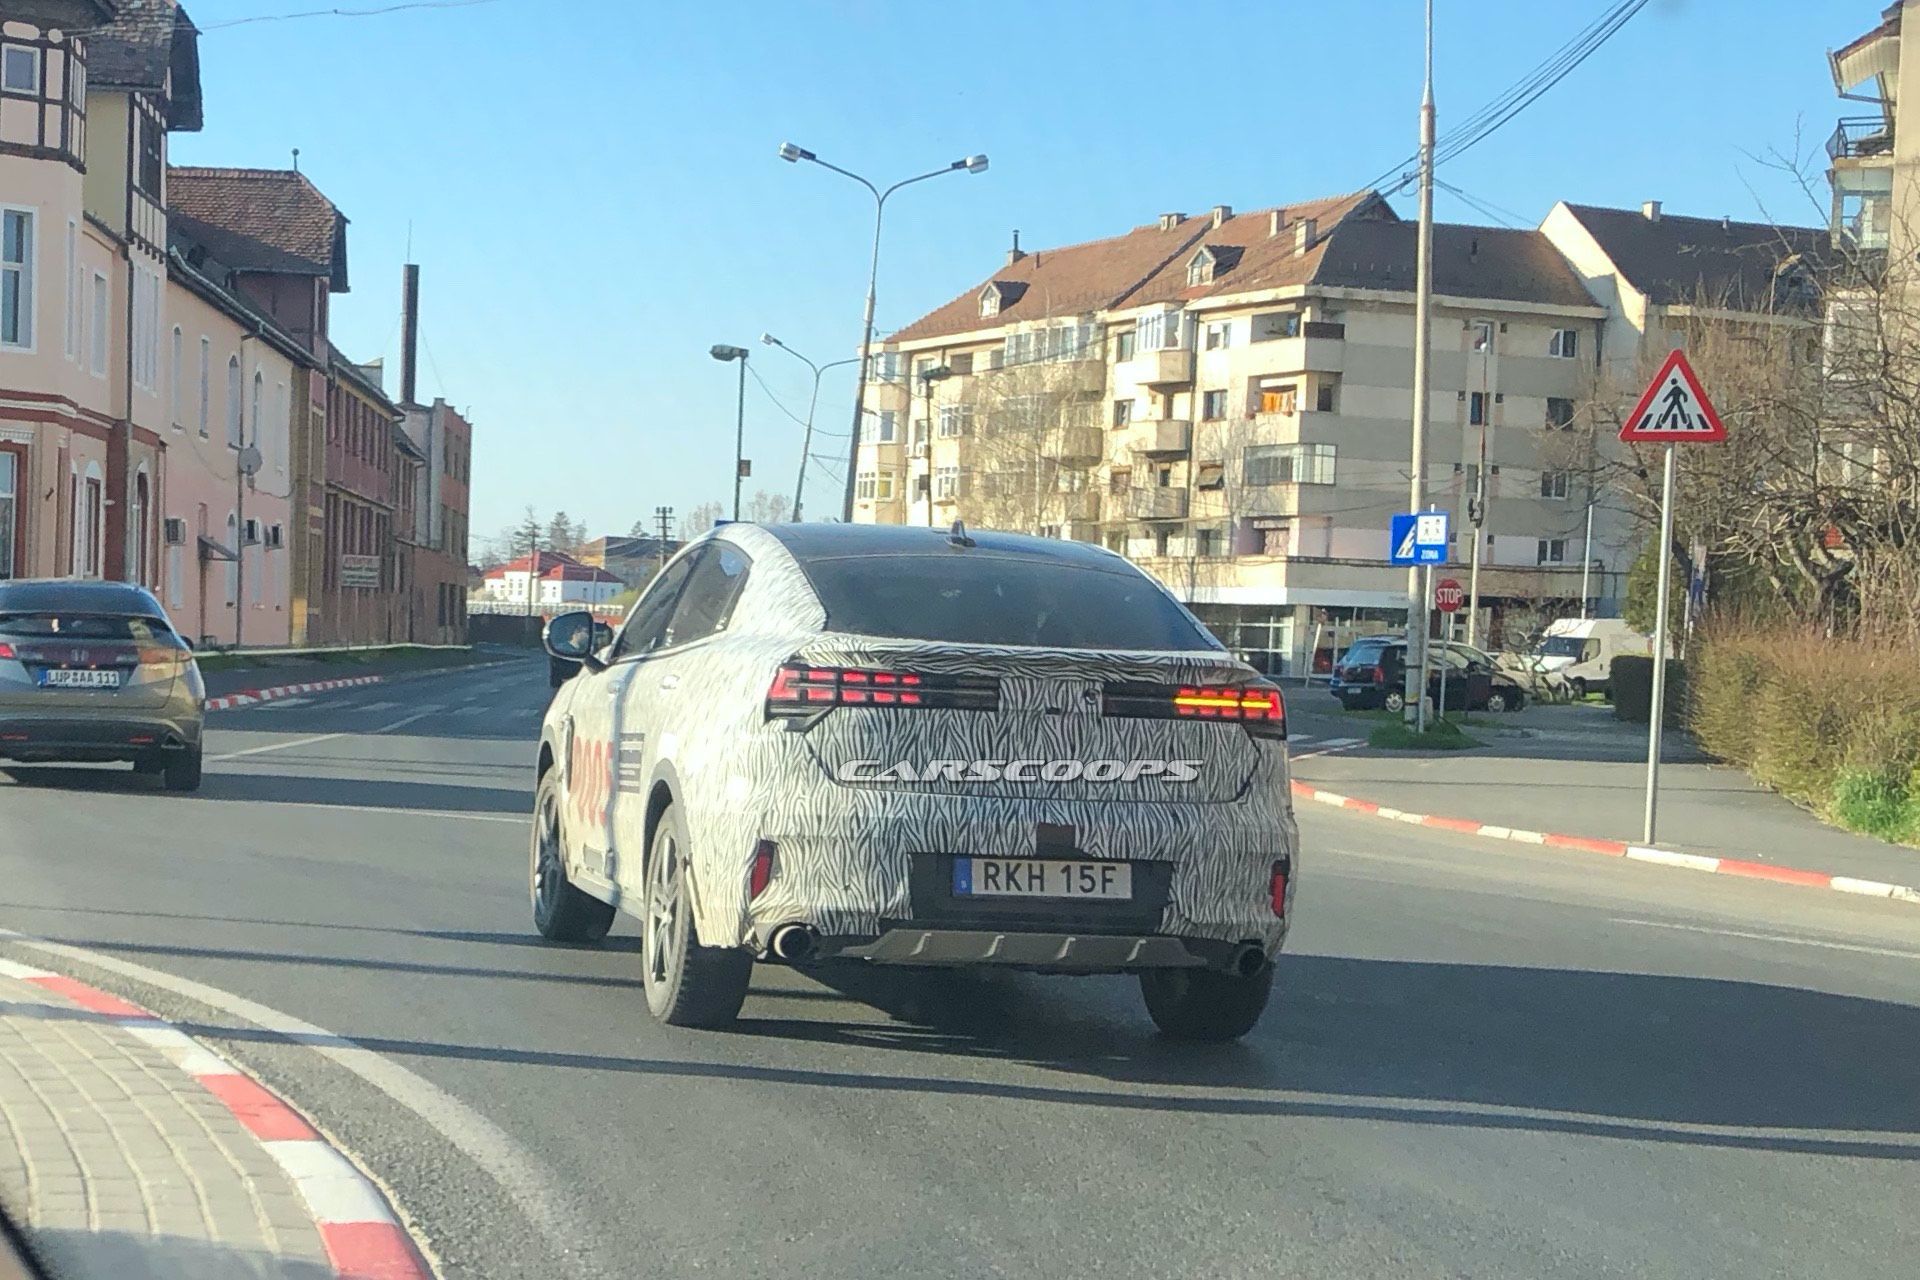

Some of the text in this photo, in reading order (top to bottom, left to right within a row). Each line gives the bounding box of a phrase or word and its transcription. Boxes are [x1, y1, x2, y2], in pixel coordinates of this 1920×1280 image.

[1421, 550, 1439, 560] ZONA
[1437, 588, 1462, 604] STOP
[48, 672, 117, 684] LUP AA 111
[983, 861, 1117, 894] RKH 15F
